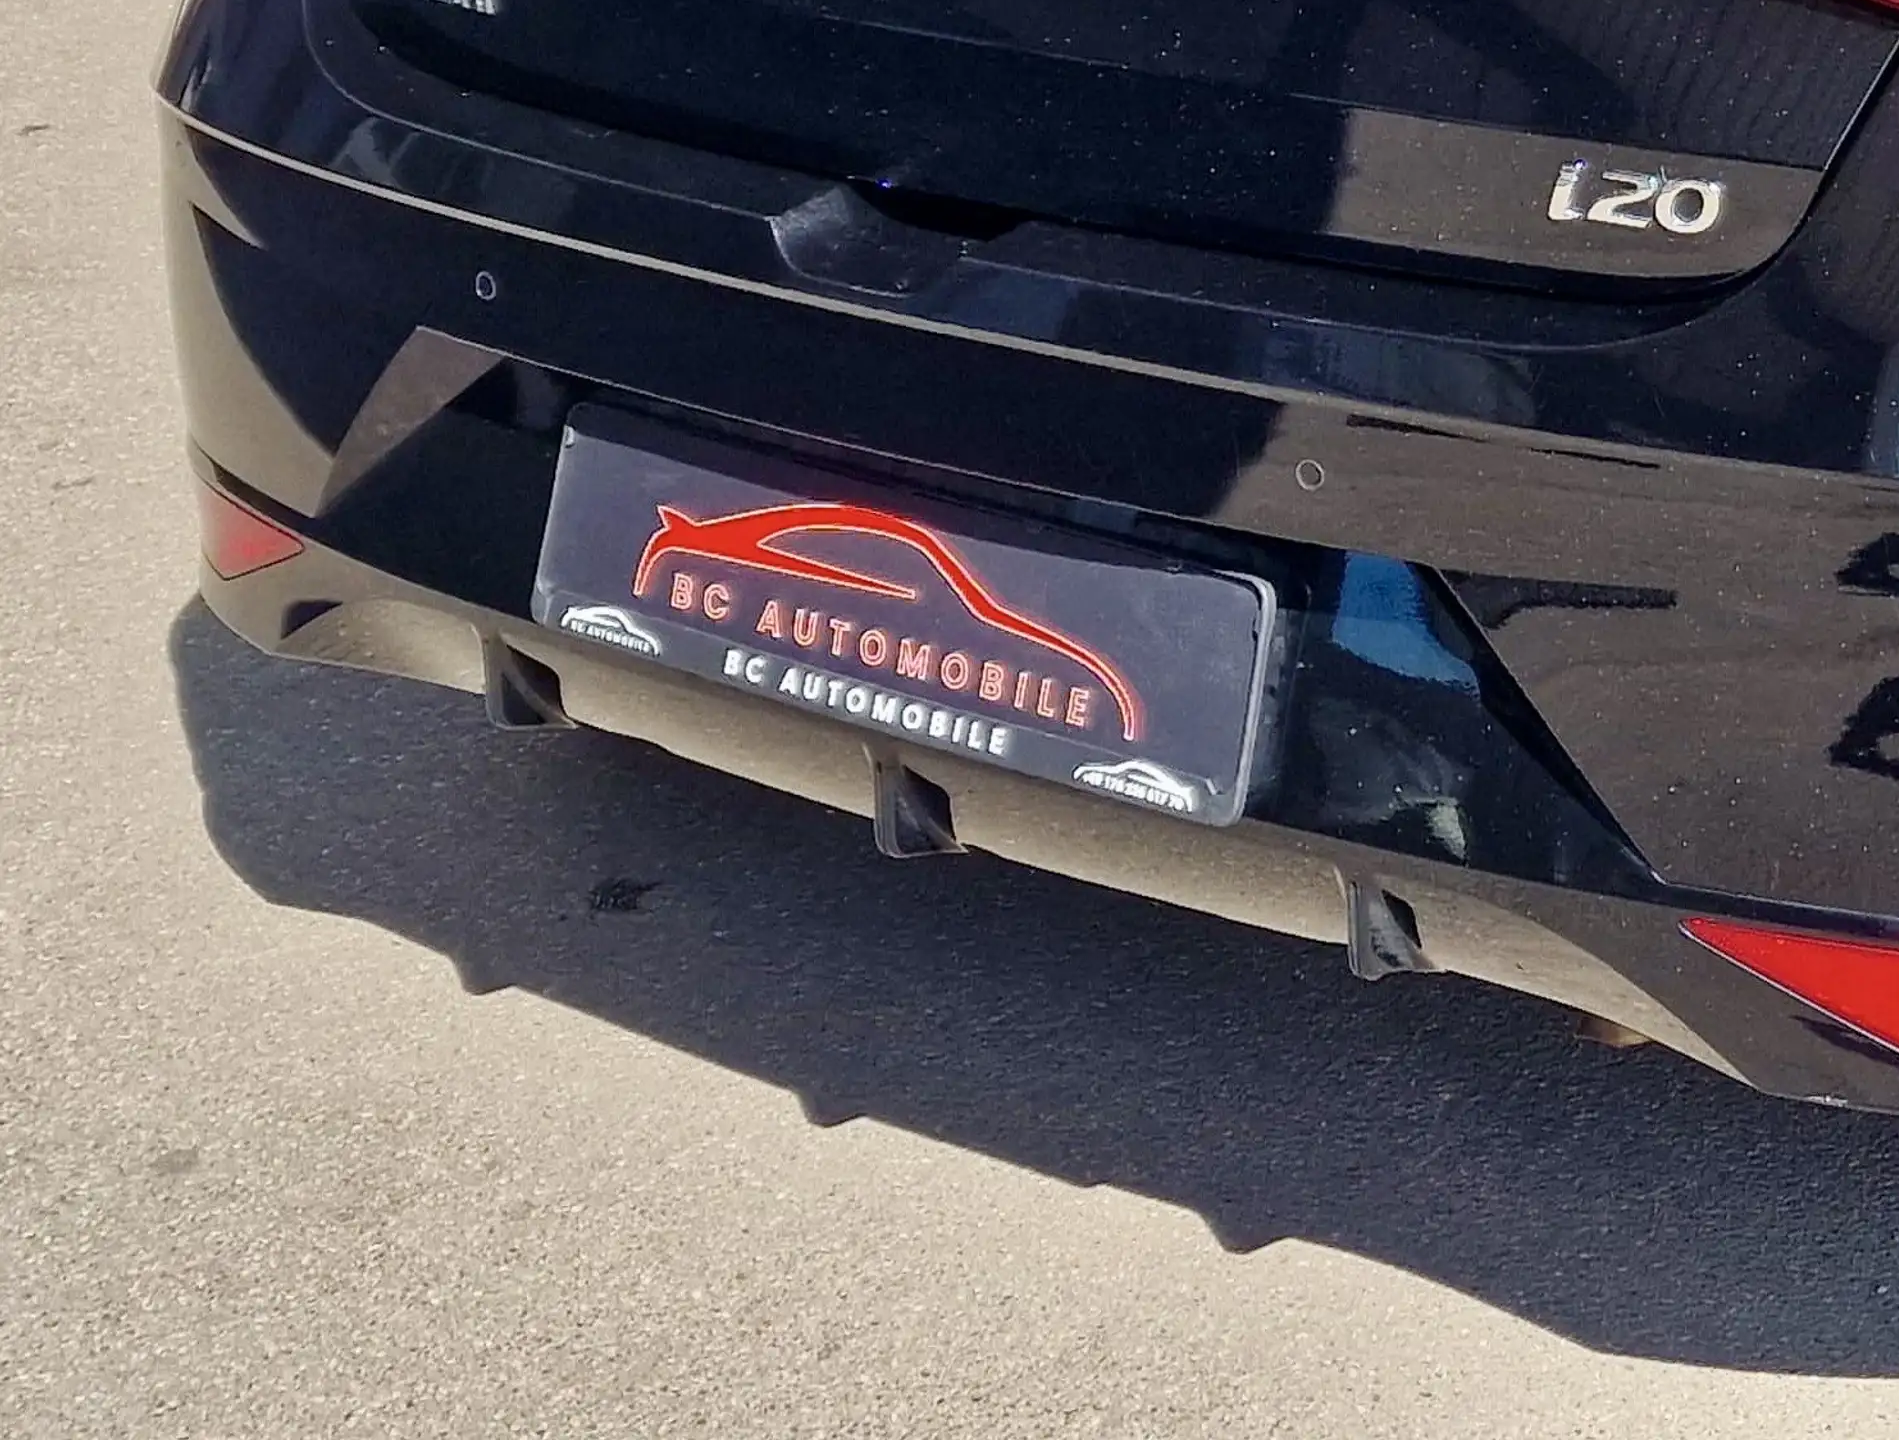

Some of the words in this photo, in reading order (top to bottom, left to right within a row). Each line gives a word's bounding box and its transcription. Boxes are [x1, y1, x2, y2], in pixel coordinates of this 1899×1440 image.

[670, 572, 731, 621] BC
[755, 599, 1092, 728] AUTOMOBILE
[723, 649, 766, 684] BC
[778, 666, 1008, 756] AUTOMOBILE
